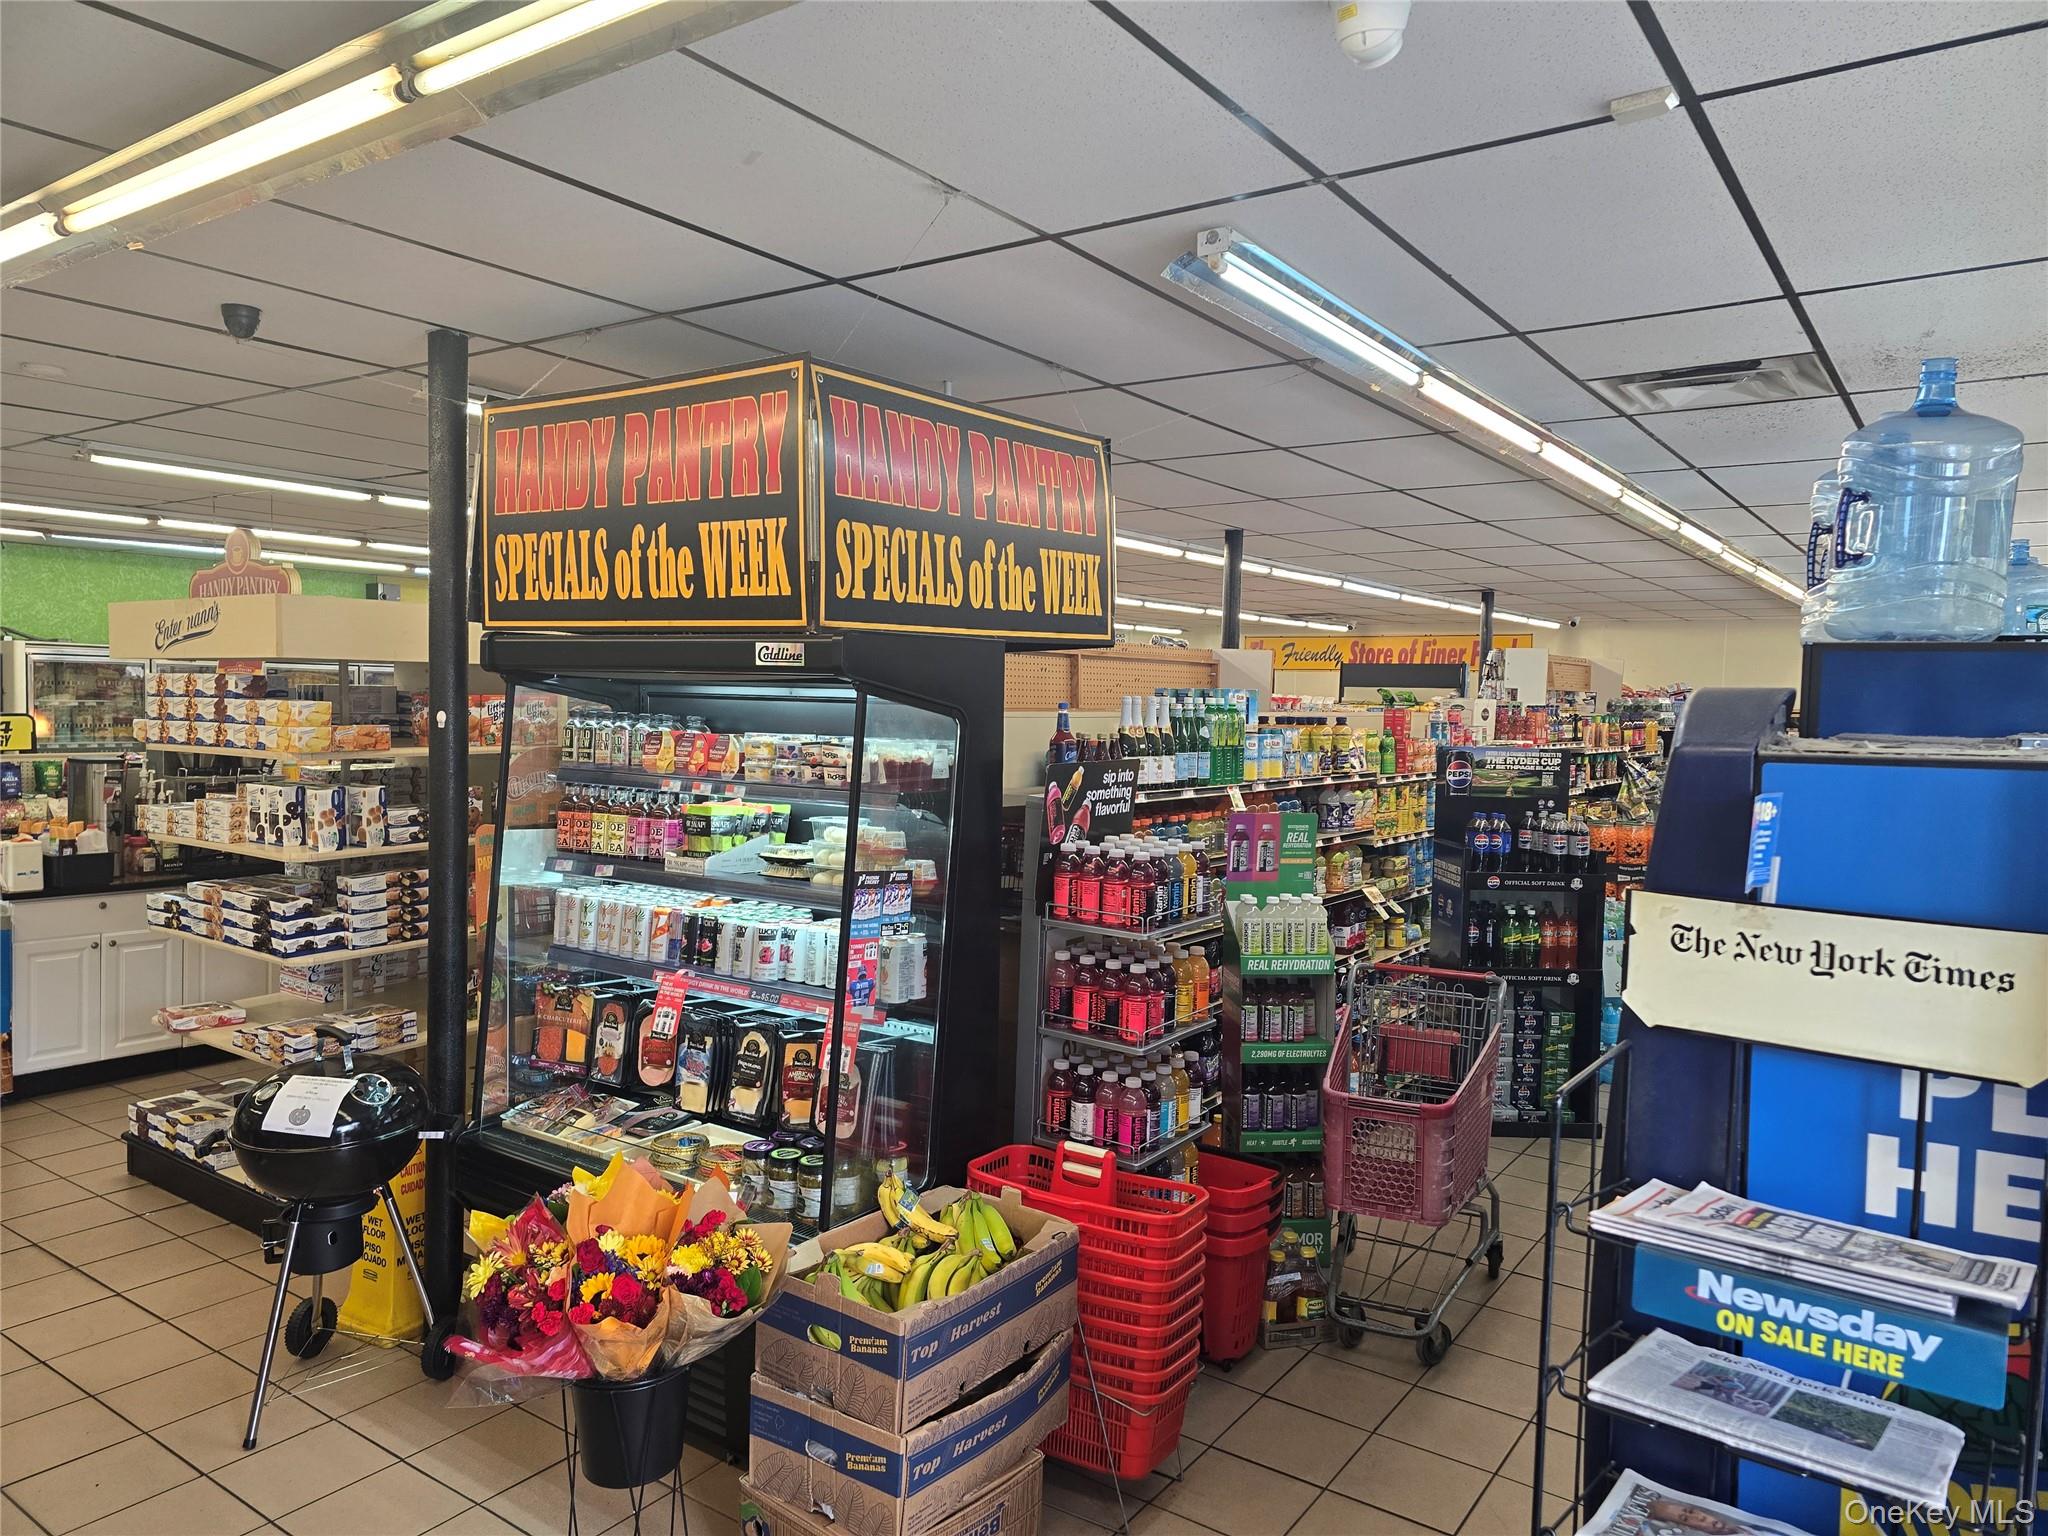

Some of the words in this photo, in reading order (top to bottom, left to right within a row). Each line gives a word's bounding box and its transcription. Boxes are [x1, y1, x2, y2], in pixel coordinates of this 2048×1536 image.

[494, 414, 616, 516] HANDY
[622, 390, 790, 506] PANTRY
[829, 394, 961, 516] HANDY
[968, 430, 1096, 537] PANTRY
[494, 527, 608, 602] SPECIALS
[614, 528, 646, 601] of
[647, 523, 694, 600] the
[698, 517, 792, 599] WEEK
[836, 518, 963, 608] SPECIALS
[968, 541, 998, 610] of
[998, 541, 1036, 612] the
[1040, 548, 1103, 617] WEEK
[200, 577, 237, 597] HANDY
[236, 575, 280, 596] PANTRY
[758, 644, 803, 664] Coldline
[1282, 642, 1344, 666] Friendly
[1350, 640, 1392, 664] Store
[1398, 641, 1417, 664] of
[1420, 639, 1466, 664] Finer
[494, 711, 504, 722] Bit
[1506, 757, 1539, 765] RYDER
[1103, 770, 1116, 786] sip
[1118, 769, 1134, 782] into
[1448, 770, 1471, 778] PEPSI
[1086, 786, 1132, 801] something
[1096, 801, 1130, 816] flavorful
[576, 820, 590, 828] OE
[592, 821, 603, 830] OE
[610, 822, 624, 831] OE
[575, 840, 589, 848] EA
[1287, 832, 1308, 843] REAL
[610, 843, 623, 852] EA
[1172, 882, 1180, 918] vitamin
[1248, 960, 1269, 970] REAL
[1271, 960, 1330, 970] REHYDRATION
[1671, 923, 1728, 960] The
[1734, 931, 1802, 966] New
[1810, 940, 1895, 980] York
[1904, 950, 2016, 994] Times
[719, 985, 730, 993] THE
[730, 986, 748, 996] WORLD
[760, 993, 779, 1003] $5.00
[400, 1179, 425, 1195] CUIDAD
[1710, 1202, 1743, 1221] sday
[368, 1215, 383, 1228] WET
[363, 1225, 386, 1240] FLOOR
[407, 1224, 425, 1236] LOO
[364, 1241, 382, 1254] PISO
[412, 1238, 425, 1250] ISO
[362, 1254, 387, 1268] OJADO
[1696, 1268, 1943, 1362] Newsday
[911, 1340, 939, 1364] Top
[950, 1301, 1002, 1342] Harvest
[851, 1344, 888, 1355] Bananas
[1717, 1308, 1754, 1339] ON
[1761, 1321, 1826, 1360] SALE
[1833, 1339, 1904, 1379] HERE
[1709, 1353, 1742, 1366] The
[1744, 1362, 1783, 1378] New
[1786, 1375, 1833, 1393] York
[1836, 1389, 1896, 1412] Times
[913, 1456, 941, 1481] Top
[953, 1414, 1008, 1458] Harvest
[847, 1461, 886, 1472] Bananas
